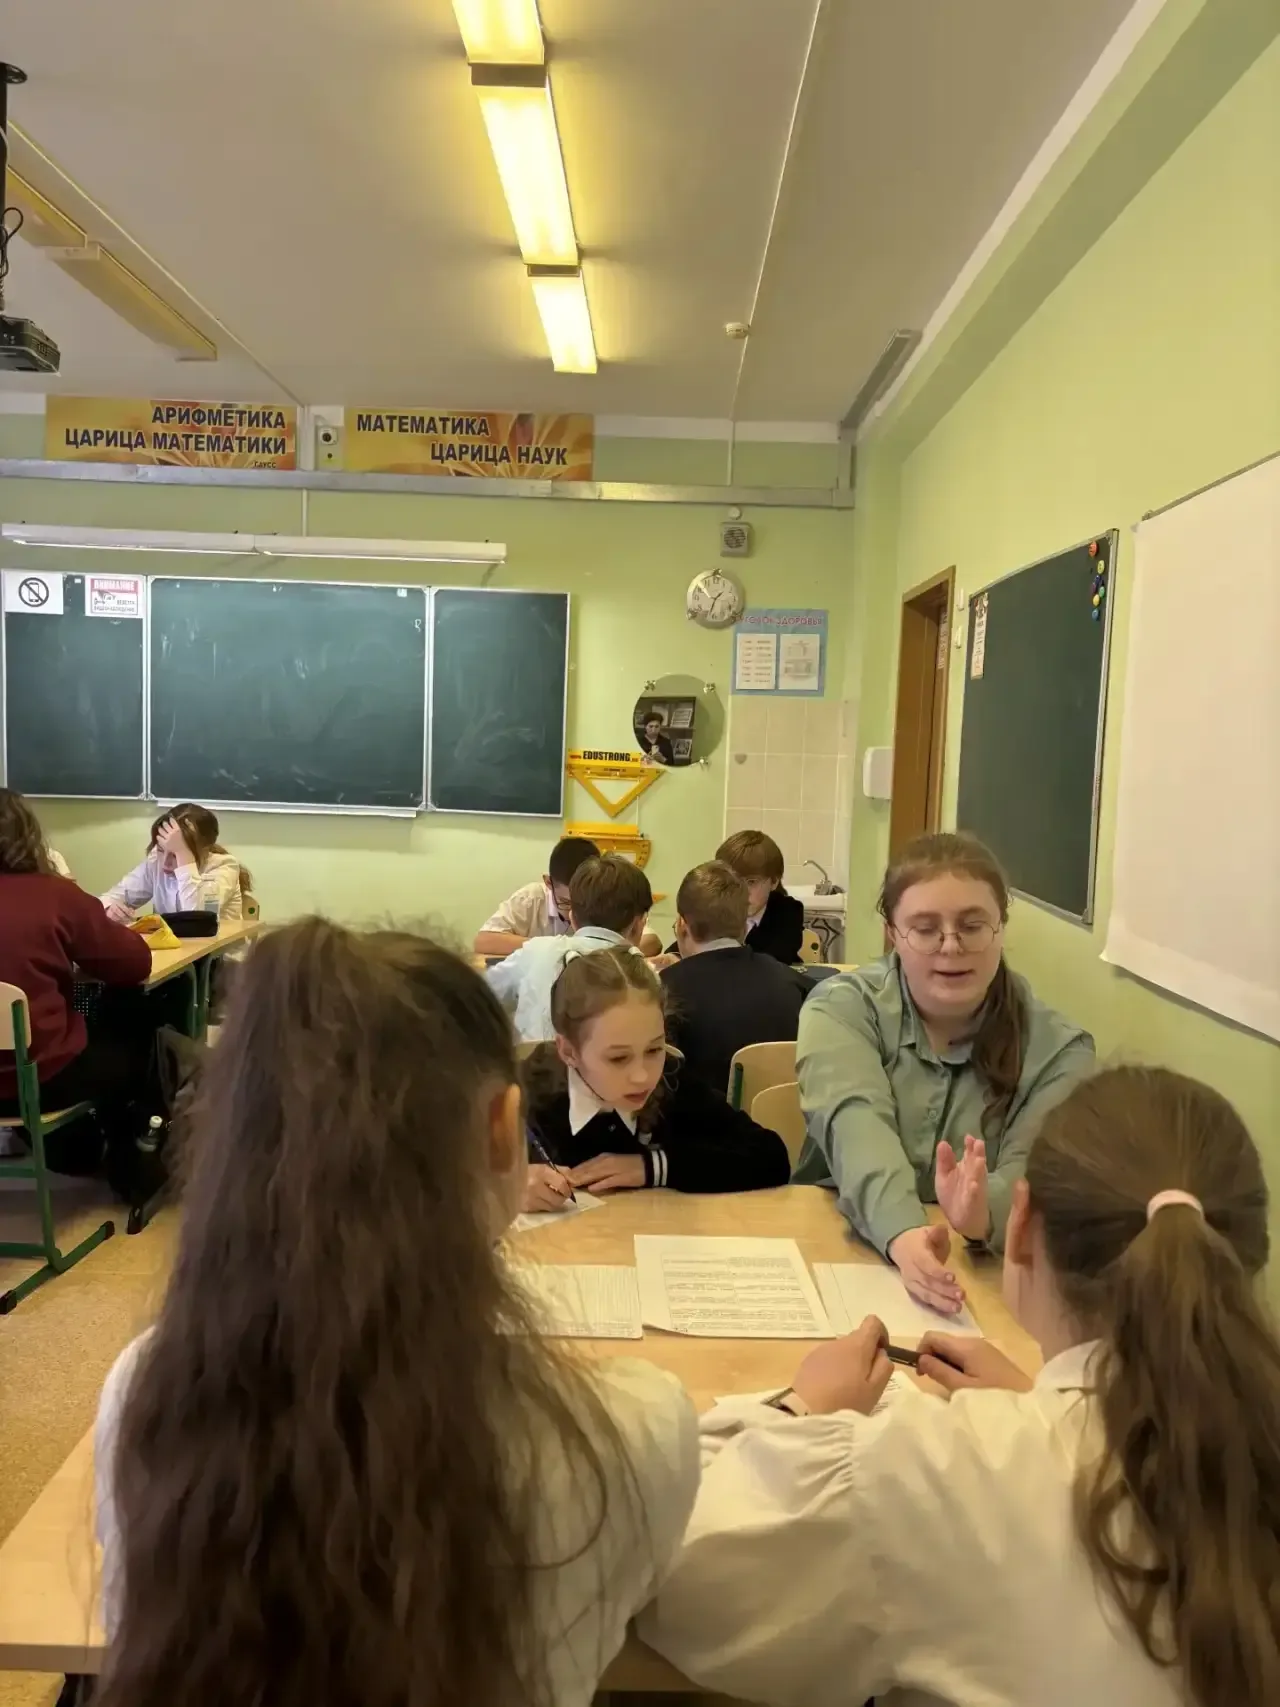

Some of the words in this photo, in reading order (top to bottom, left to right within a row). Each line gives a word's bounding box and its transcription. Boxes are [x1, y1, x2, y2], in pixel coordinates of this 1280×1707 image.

[151, 405, 286, 429] АРИФМЕТИКА
[357, 413, 490, 436] МАТЕМАТИКА
[65, 428, 146, 452] ЦАРИЦА
[152, 431, 286, 455] МАТЕМАТИКИ
[254, 460, 277, 469] ГАУСС
[430, 443, 511, 467] ЦАРИЦА
[517, 446, 568, 466] НАУК
[582, 750, 631, 762] EDUSTRONG
